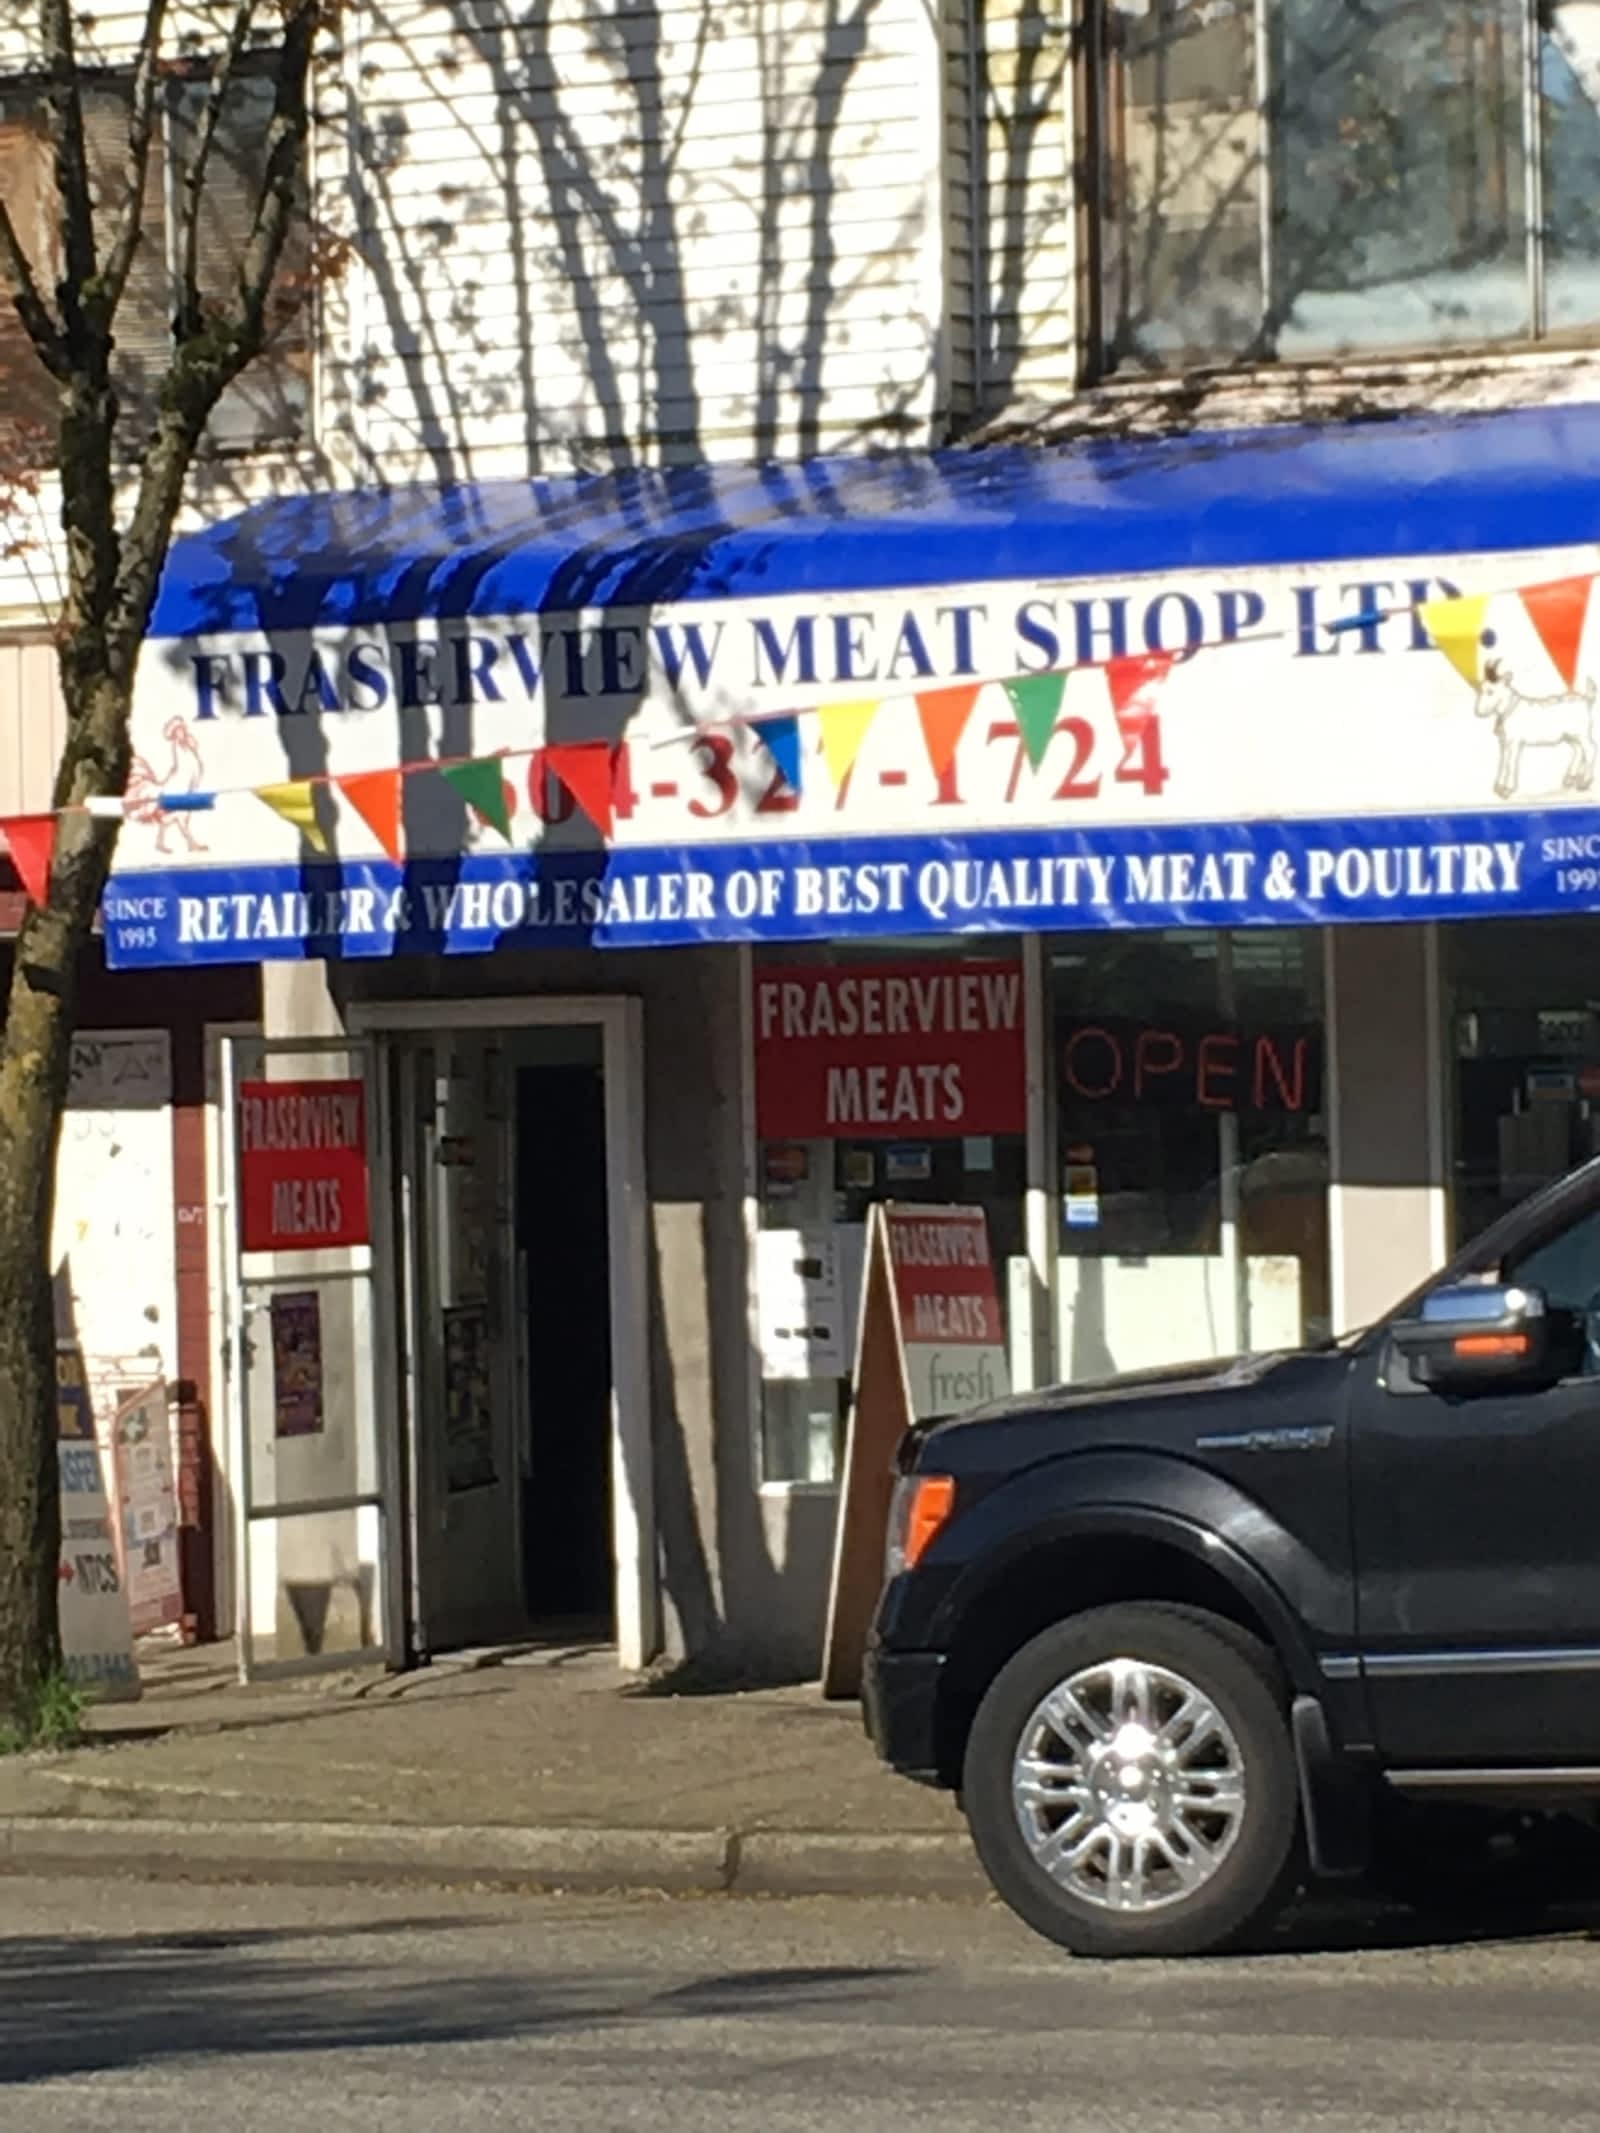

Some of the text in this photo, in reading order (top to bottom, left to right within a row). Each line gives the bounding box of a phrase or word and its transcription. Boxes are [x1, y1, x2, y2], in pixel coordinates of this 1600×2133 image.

[193, 619, 724, 719] FRASERVIEW
[749, 603, 988, 688] MEAT
[1013, 588, 1265, 672] SHOP
[1540, 833, 1600, 862] SINC
[103, 897, 168, 922] SINCE
[177, 840, 1525, 943] RETAILER & WHOLESALER OF BEST QUALITY MEAT & POULTRY
[1555, 867, 1600, 894] 199
[759, 973, 1020, 1039] FRASERVIEW
[825, 1063, 965, 1124] MEATS
[1063, 1027, 1307, 1112] OPEN
[240, 1095, 361, 1152] FRASERVIEW
[271, 1178, 342, 1235] MEATS
[913, 1293, 988, 1338] MEATS
[929, 1351, 995, 1411] fresh
